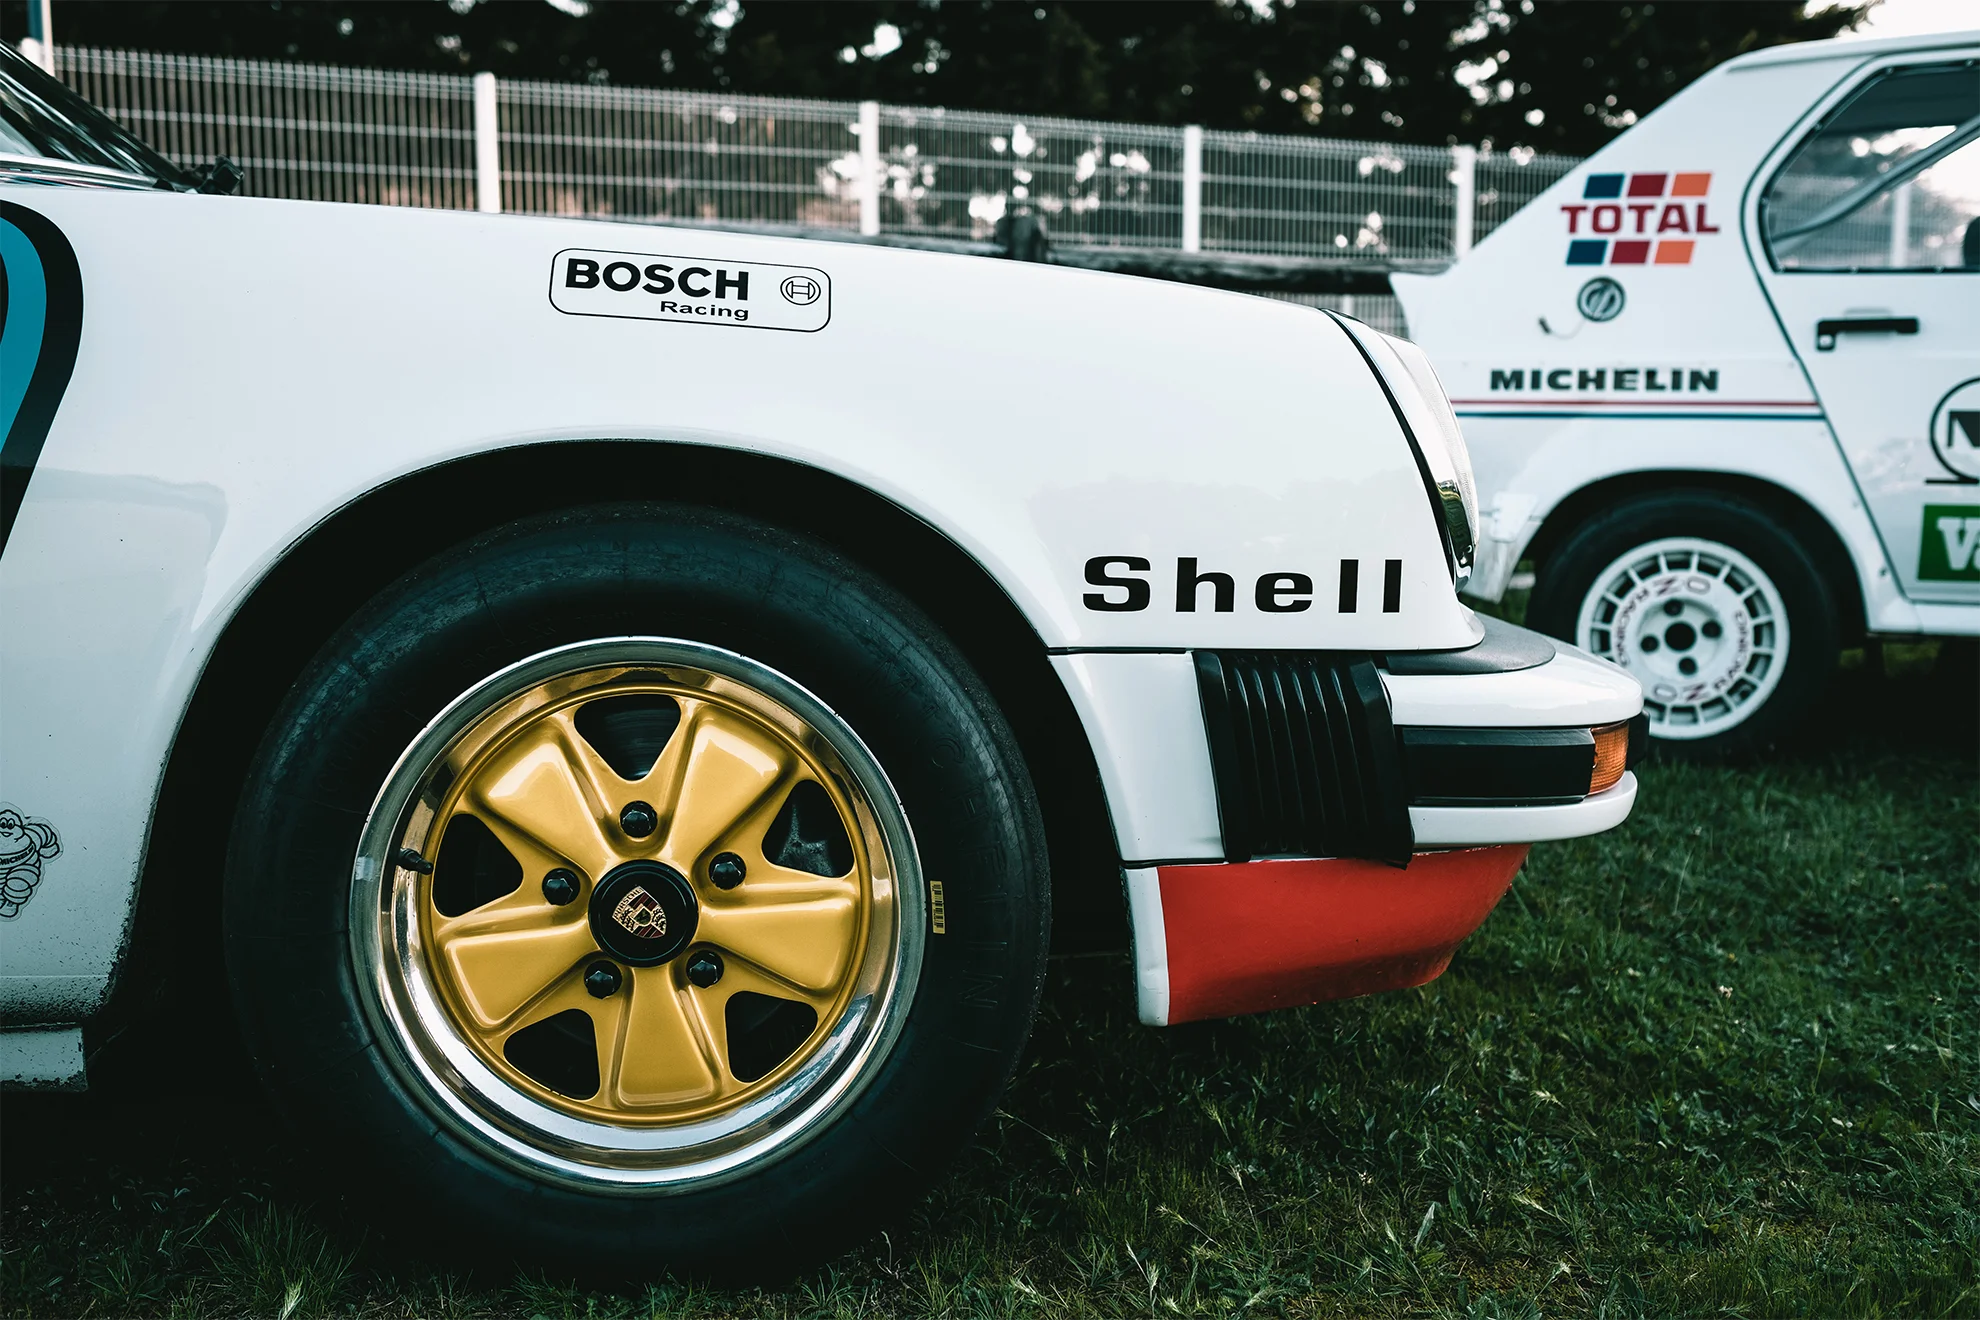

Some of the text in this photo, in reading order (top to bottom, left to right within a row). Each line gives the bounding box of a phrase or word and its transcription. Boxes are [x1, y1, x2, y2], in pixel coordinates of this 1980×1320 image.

[1560, 203, 1720, 234] TOTAL
[565, 257, 749, 301] BOSCH
[660, 300, 749, 321] Racing
[1489, 368, 1719, 392] MICHELIN
[1083, 555, 1403, 613] Shell
